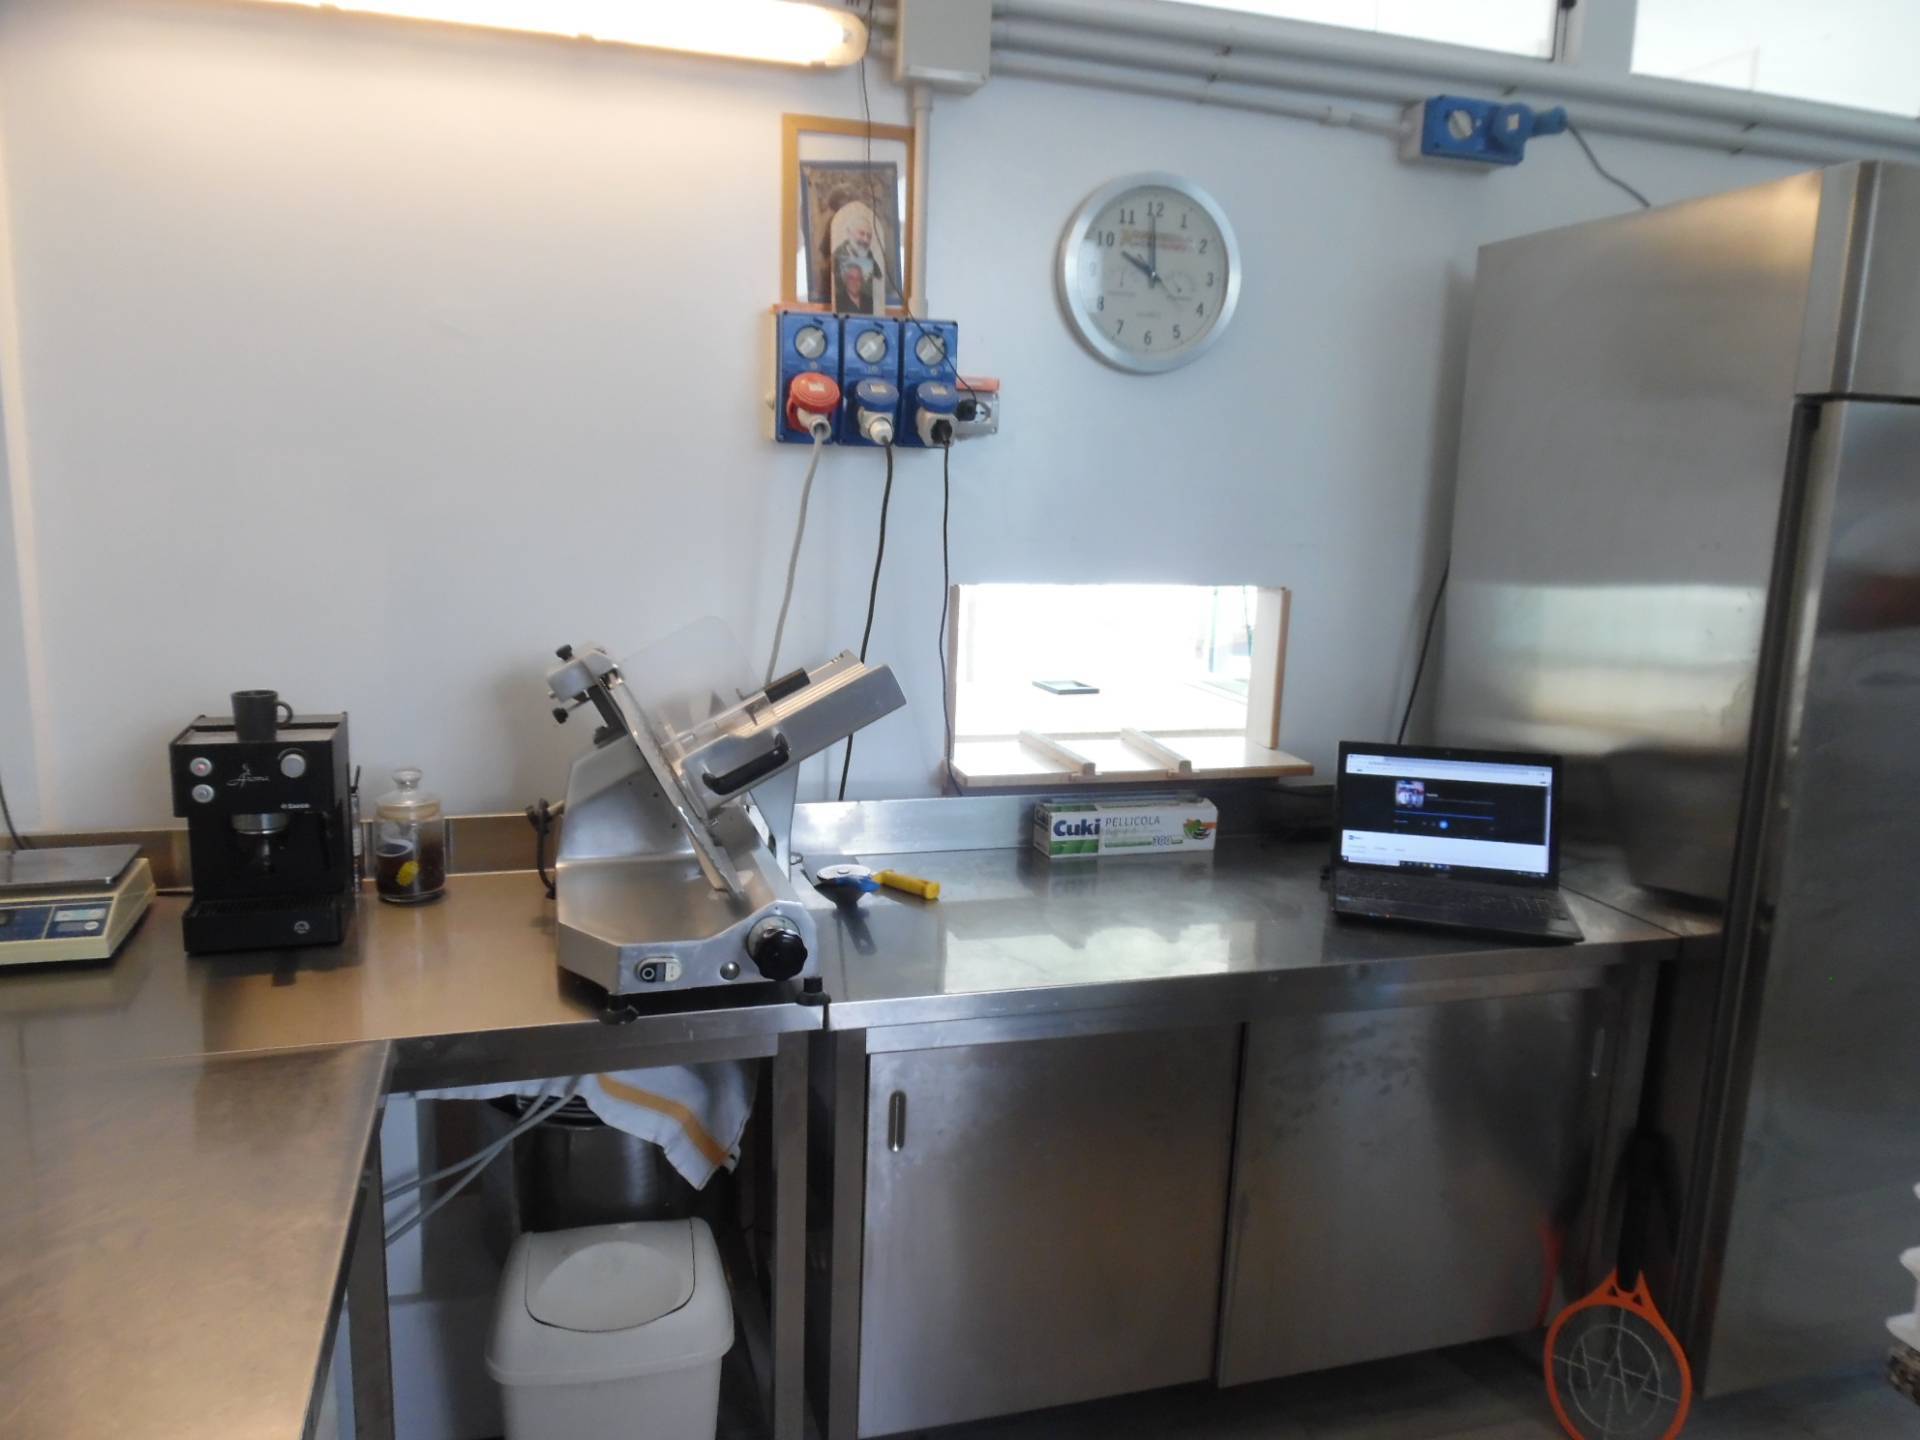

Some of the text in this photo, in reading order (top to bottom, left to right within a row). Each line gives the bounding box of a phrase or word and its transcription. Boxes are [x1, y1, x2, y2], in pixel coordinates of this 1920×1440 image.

[1119, 208, 1135, 225] 11
[1147, 202, 1164, 218] 12
[1180, 213, 1188, 229] 1
[1098, 231, 1115, 247] 10
[1199, 239, 1208, 254] 2
[1206, 272, 1214, 287] 3
[1097, 296, 1105, 311] 8
[1196, 303, 1204, 316] 4
[1116, 319, 1124, 335] 7
[1172, 324, 1181, 340] 5
[1144, 330, 1152, 345] 6
[1053, 818, 1101, 837] Cuki
[1105, 815, 1161, 828] PELLICOLA
